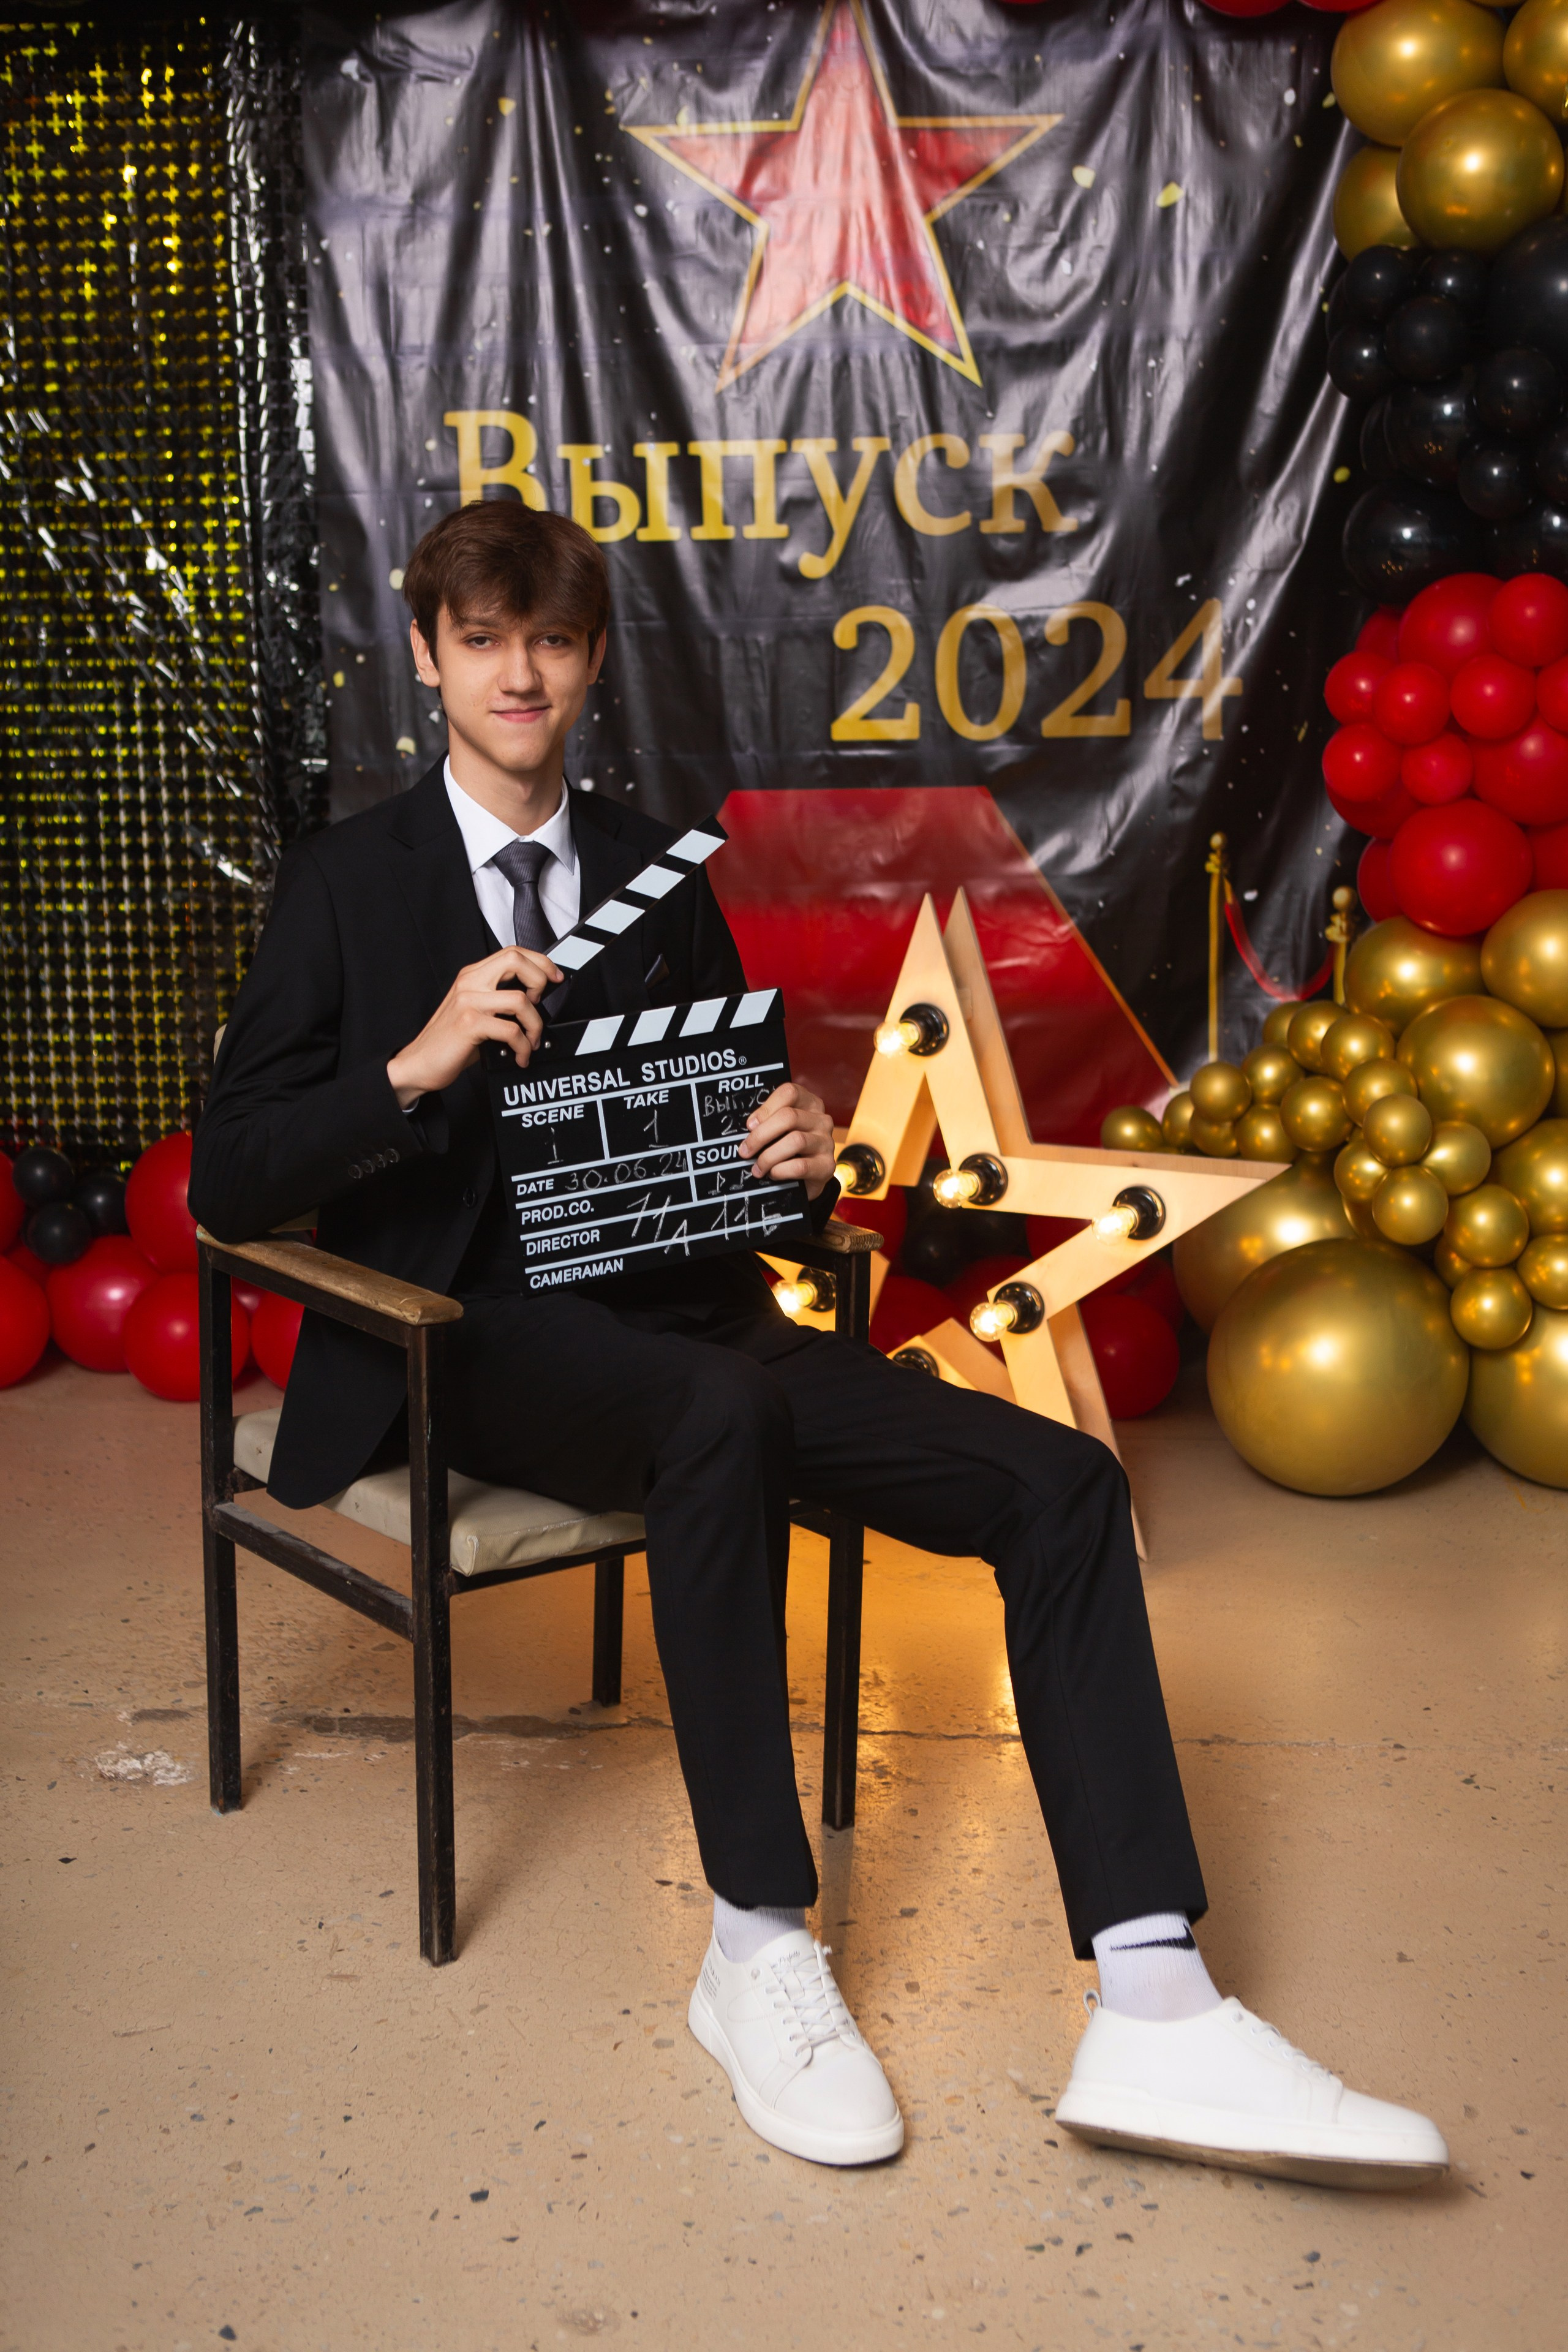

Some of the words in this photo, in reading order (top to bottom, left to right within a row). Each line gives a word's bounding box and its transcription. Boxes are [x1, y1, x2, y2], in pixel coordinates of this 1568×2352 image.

[443, 410, 1078, 579] Выпуск
[830, 597, 1243, 742] 2024
[503, 1068, 630, 1106] UNIVERSAL
[718, 1074, 764, 1093] ROLL
[624, 1090, 669, 1109] TAKE
[521, 1104, 584, 1128] SCENE
[565, 1152, 687, 1191] 30.06.24
[516, 1178, 554, 1196] DATE
[521, 1200, 594, 1225] PROD.CO.
[526, 1229, 600, 1256] DIRECTOR
[530, 1257, 624, 1289] CAMERAMAN
